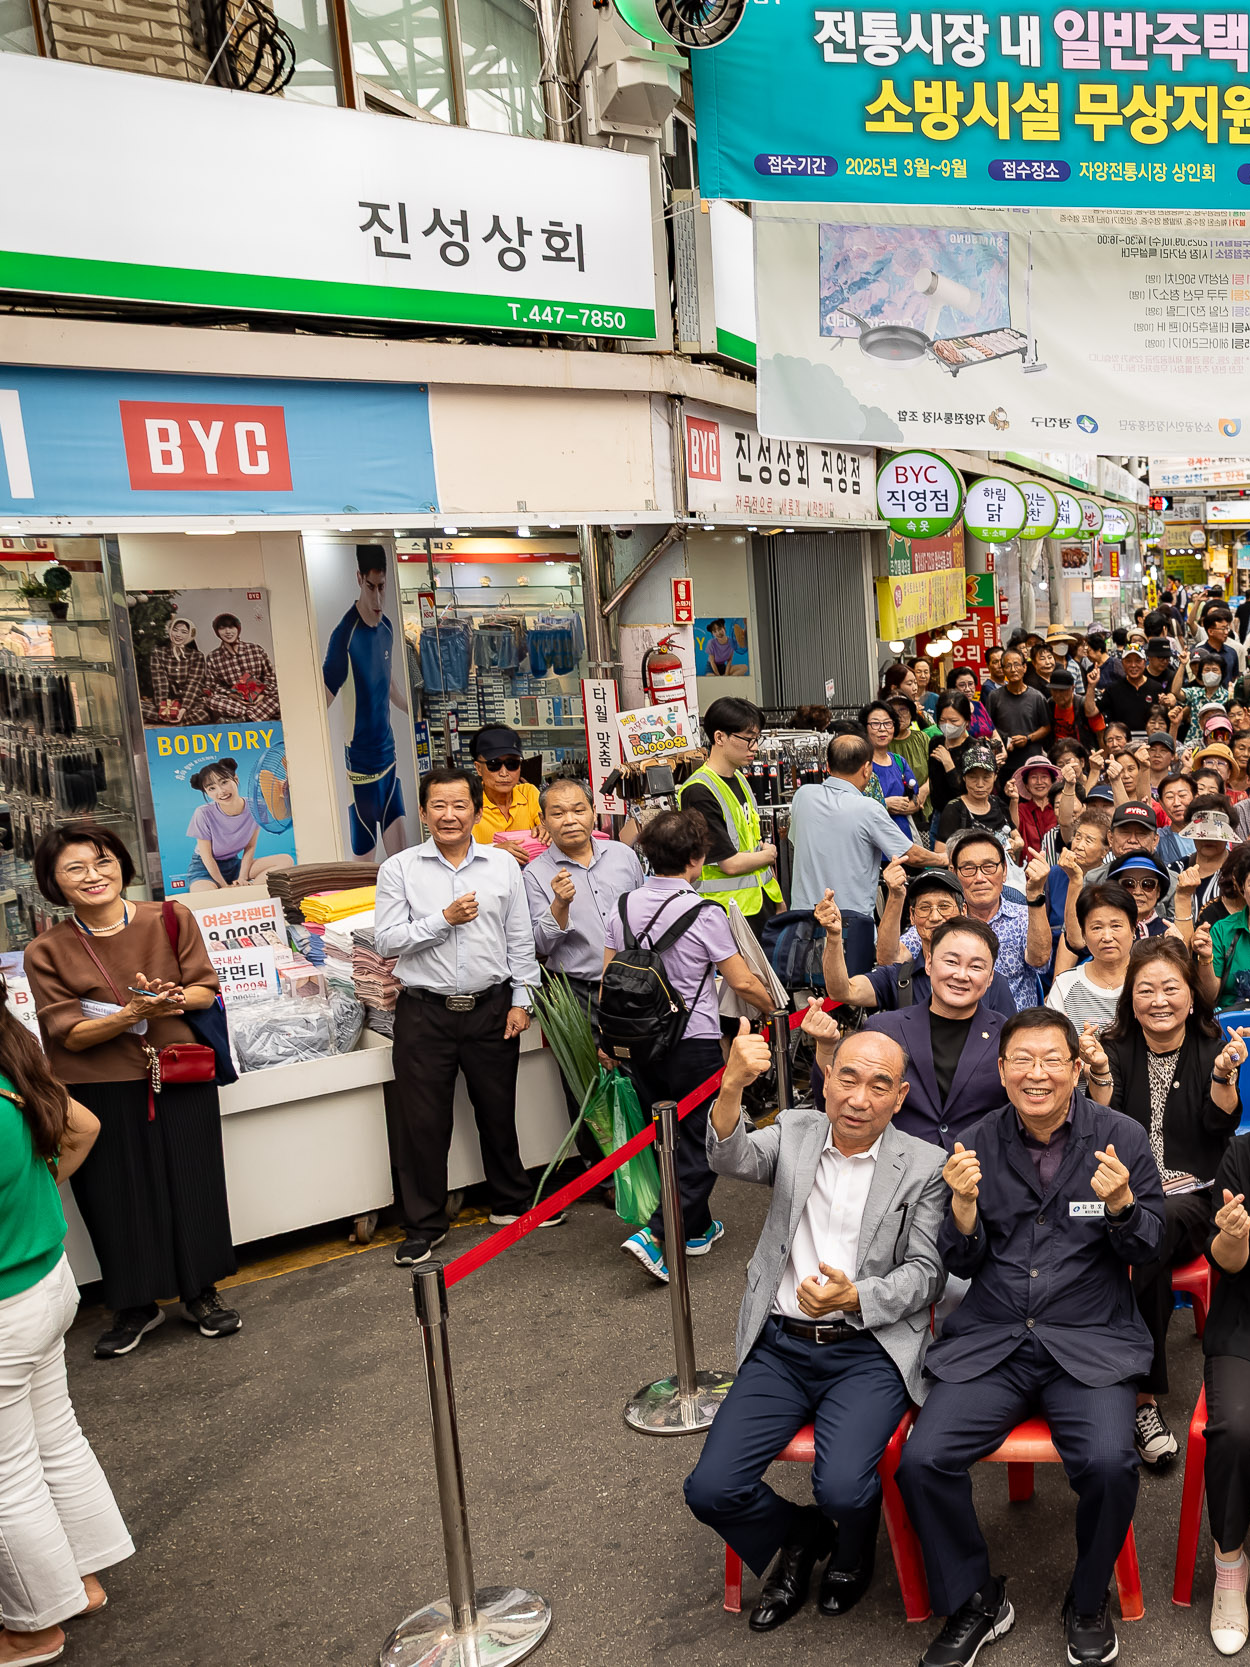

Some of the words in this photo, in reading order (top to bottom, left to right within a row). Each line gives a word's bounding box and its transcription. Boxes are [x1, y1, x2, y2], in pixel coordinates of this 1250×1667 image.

[814, 10, 990, 67] 전통시장
[1001, 13, 1041, 67] 내
[1054, 10, 1250, 73] 일반주택
[865, 80, 1061, 143] 소방시설
[767, 156, 827, 175] 접수기간
[846, 158, 899, 178] 2025년
[904, 158, 968, 179] 3월~9월
[1002, 161, 1060, 180] 접수장소
[1079, 161, 1167, 183] 자양전통시장
[1172, 162, 1216, 183] 상인회
[358, 201, 587, 272] 진성상회
[508, 302, 626, 332] T.447-7850
[144, 417, 271, 476] BYC
[690, 428, 718, 475] BYC
[735, 432, 809, 488] 진성상회
[821, 450, 861, 496] 직영점
[895, 465, 938, 484] BYC
[887, 488, 949, 513] 직영점
[983, 487, 1007, 502] 하림
[986, 503, 1003, 523] 닭
[412, 541, 455, 551] 스피오
[696, 637, 705, 651] Y
[953, 645, 981, 663] 오리
[592, 686, 608, 723] 타월
[157, 733, 223, 757] BODY
[227, 728, 275, 752] DRY
[596, 731, 612, 768] 맞춤
[1125, 807, 1148, 817] PYRO
[203, 904, 276, 928] 여삼각팬티
[213, 955, 242, 965] 국내산
